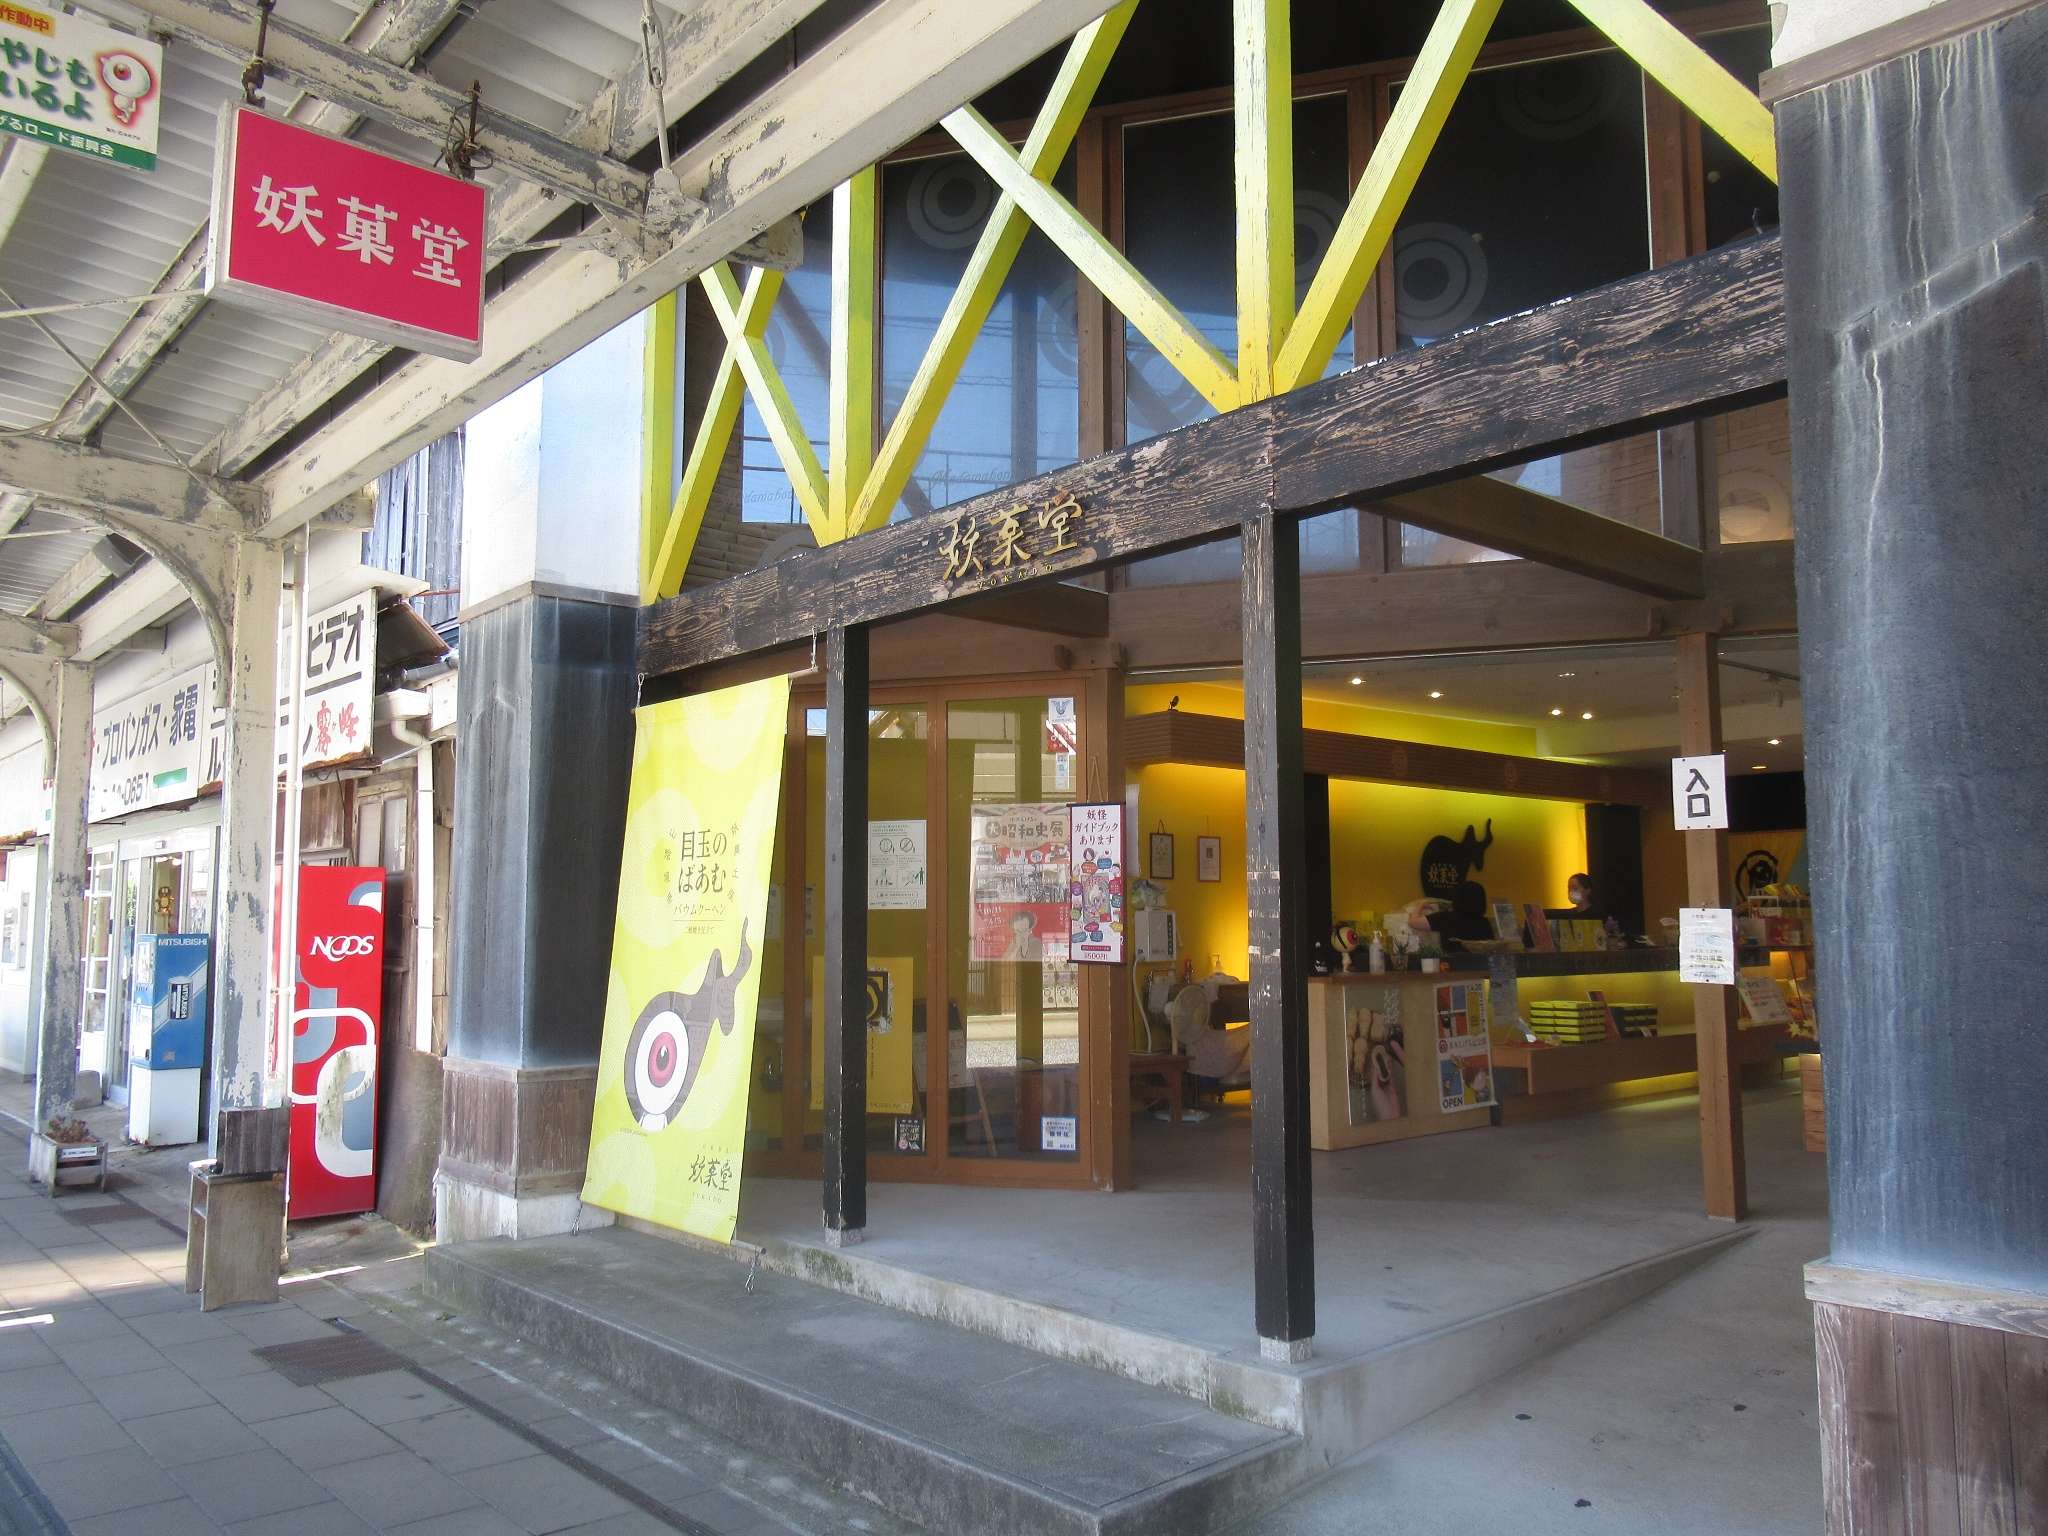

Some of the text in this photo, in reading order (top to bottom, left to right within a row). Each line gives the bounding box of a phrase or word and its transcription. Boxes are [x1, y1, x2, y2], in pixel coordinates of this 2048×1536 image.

[252, 175, 469, 287] 妖菓堂
[939, 494, 1083, 581] 妖菓堂
[978, 564, 1053, 590] YOKADO
[306, 604, 364, 678] ビデオ
[1685, 768, 1710, 818] 入口
[1074, 822, 1119, 832] ガイドブック
[1087, 809, 1107, 820] 妖怪
[681, 828, 727, 861] 目玉の
[1080, 835, 1114, 845] あります
[678, 863, 726, 894] ばあむ
[673, 903, 726, 915] バウムクーヘン
[158, 938, 208, 946] MITSUBISHI
[310, 935, 375, 962] NOOS
[1442, 1097, 1464, 1109] OPEN
